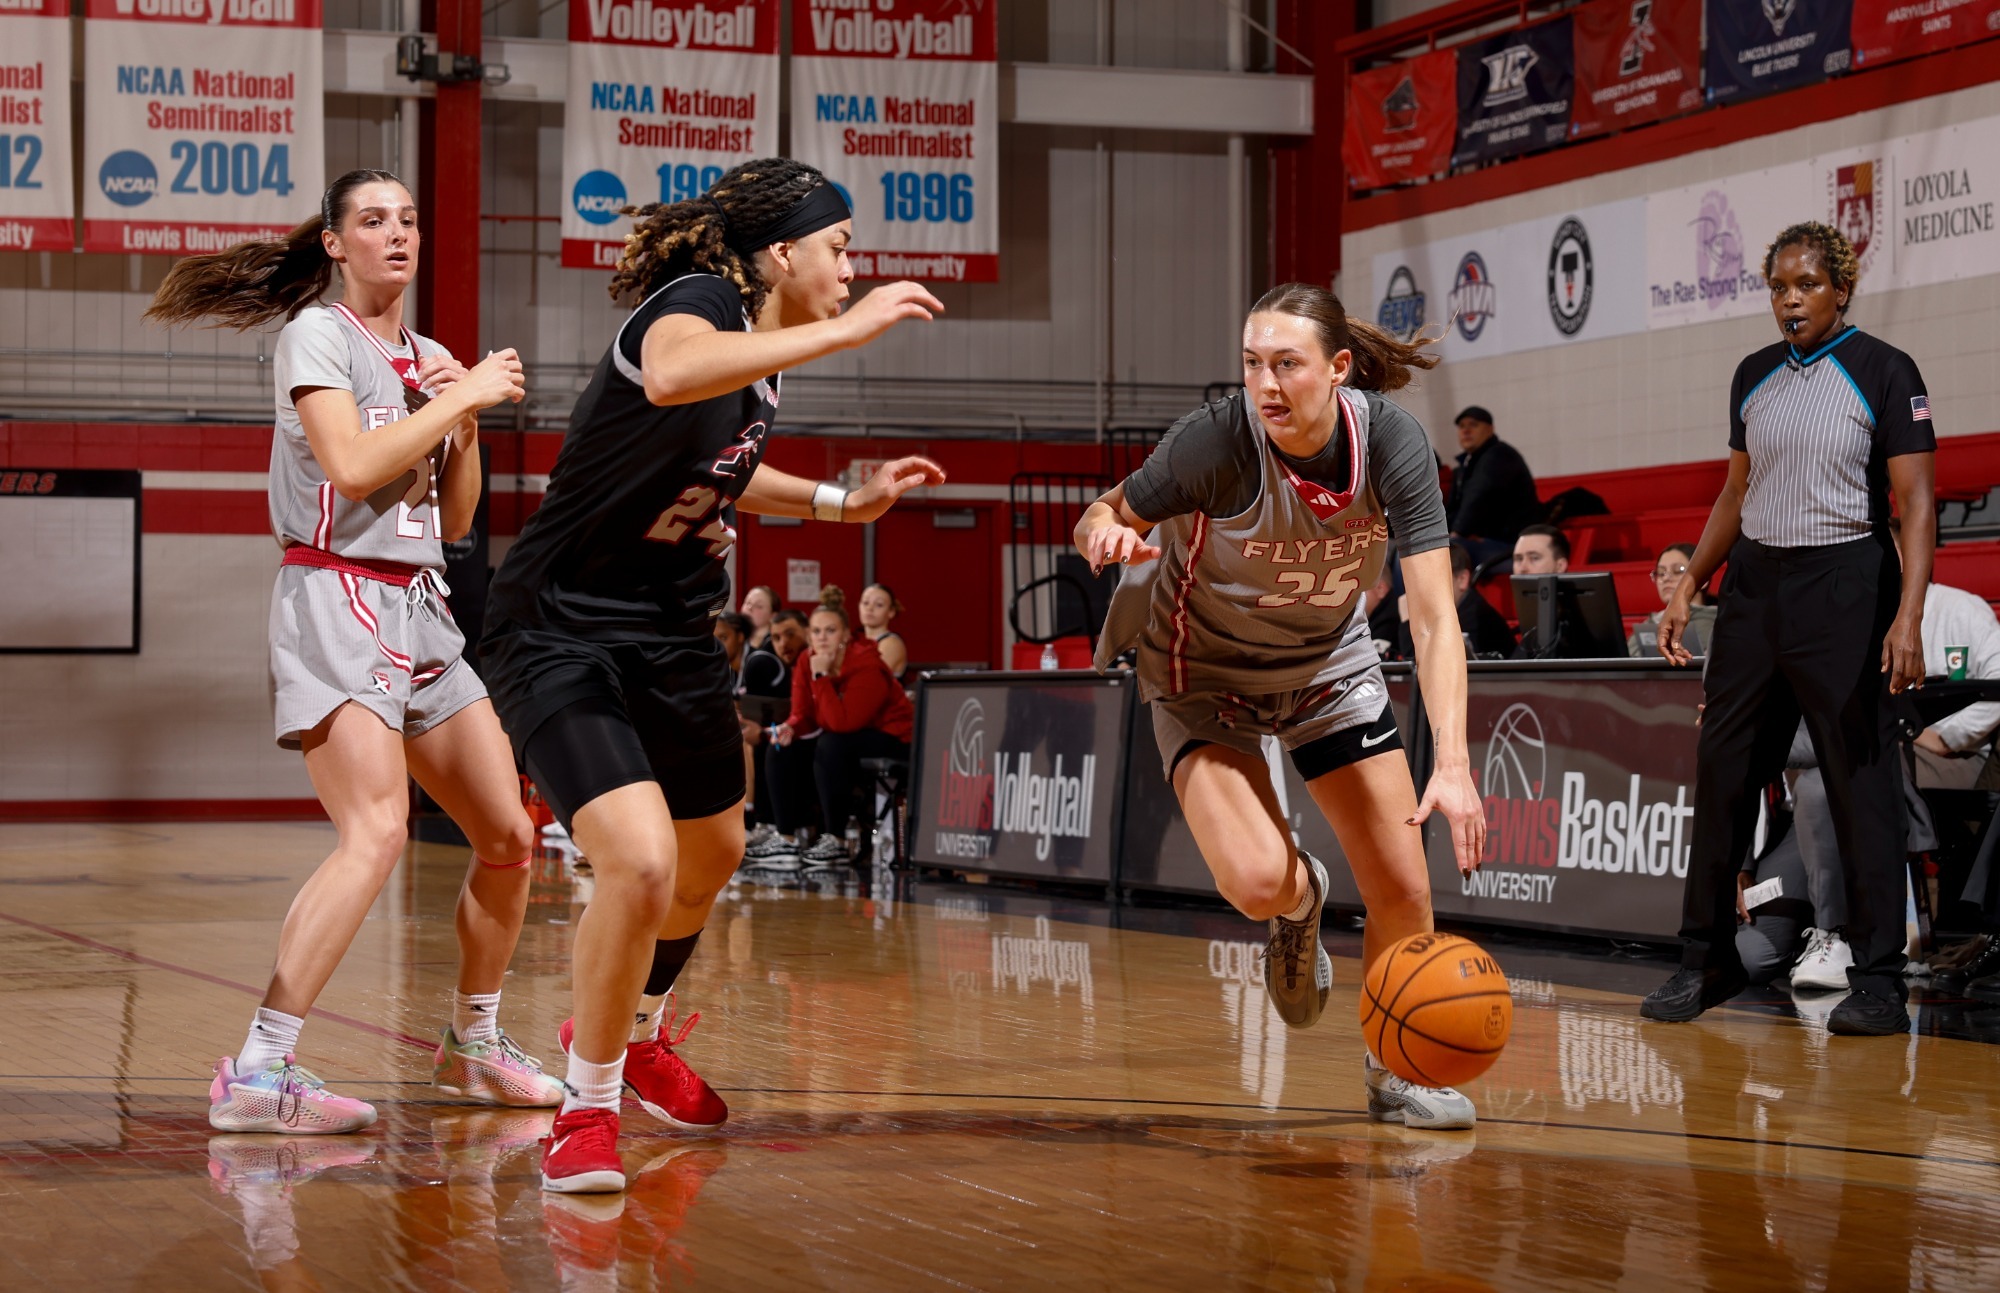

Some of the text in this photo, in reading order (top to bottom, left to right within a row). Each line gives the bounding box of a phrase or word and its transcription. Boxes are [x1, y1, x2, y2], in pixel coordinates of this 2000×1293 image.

[588, 0, 756, 49] Volleyball
[810, 9, 973, 60] Volleyball
[116, 65, 295, 101] NCAA National
[591, 81, 756, 120] NCAA National
[147, 100, 295, 135] Semifinalist
[815, 93, 975, 127] NCAA National
[618, 117, 755, 154] Semifinalist
[843, 128, 975, 160] Semifinalist
[104, 177, 157, 194] NCAA
[169, 139, 295, 197] 2004
[880, 171, 975, 224] 1996
[1903, 167, 1972, 207] LOYOLA
[123, 225, 181, 250] Lewis
[1903, 202, 1995, 247] MEDICINE
[876, 253, 967, 281] University
[1650, 284, 1671, 308] The
[1673, 280, 1696, 303] Rae
[1698, 277, 1738, 301] Strong
[0, 472, 57, 494] ERS
[1242, 523, 1388, 564] FLYERS
[1256, 557, 1365, 609] 25
[937, 750, 1097, 862] Lewis Volleyball
[935, 831, 992, 860] UNIVERSITY
[1460, 868, 1557, 903] UNIVERSITY
